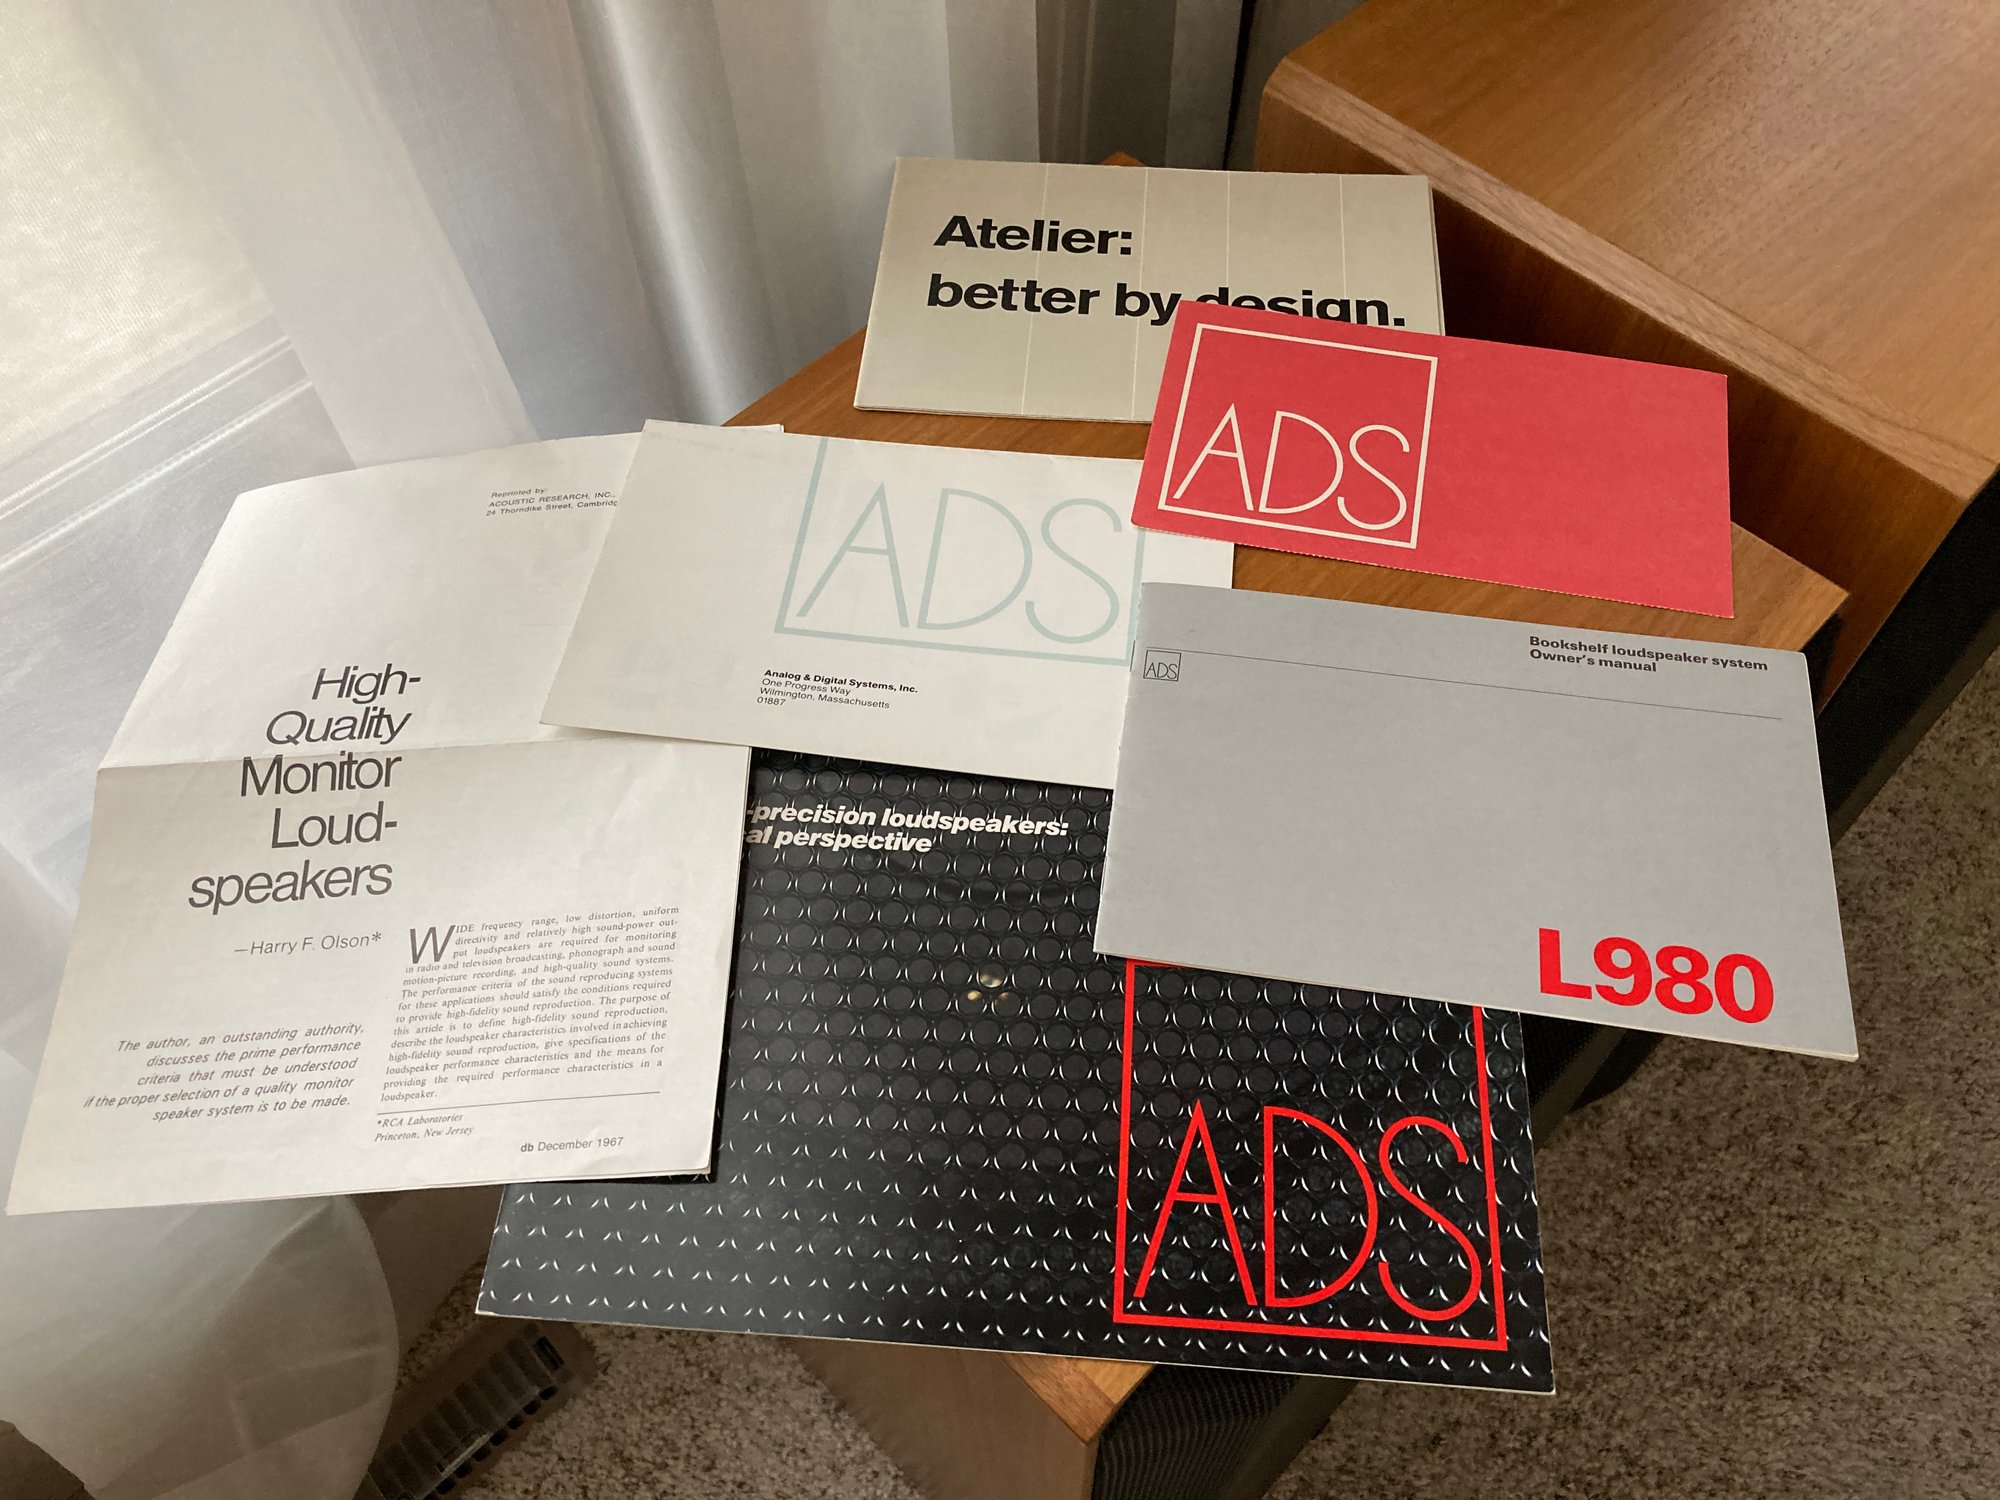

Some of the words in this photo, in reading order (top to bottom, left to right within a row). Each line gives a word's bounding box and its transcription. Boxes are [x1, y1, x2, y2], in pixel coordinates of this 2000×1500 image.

[933, 214, 1133, 256] Atelier:
[926, 273, 1100, 315] better
[1114, 282, 1183, 327] by
[1173, 402, 1411, 531] ADS
[488, 497, 535, 508] ACOUSTIC
[538, 493, 590, 503] RESEARCH,
[491, 488, 531, 499] Reprinted
[485, 509, 496, 517] 24
[500, 505, 542, 515] Thorndike
[545, 502, 573, 511] Street,
[796, 481, 1122, 644] ADS
[1529, 635, 1609, 654] Bookshelf
[1612, 644, 1708, 665] loudspeaker
[1711, 657, 1768, 671] system
[1530, 649, 1595, 666] Owner's
[1599, 657, 1657, 673] manual
[311, 663, 421, 704] High-
[764, 669, 801, 681] Analog
[813, 674, 847, 686] Digital
[849, 679, 897, 692] Systems,
[899, 684, 918, 693] Inc.
[1145, 662, 1178, 680] ADS
[756, 697, 786, 706] 01887
[760, 687, 814, 701] Wilmington,
[818, 694, 890, 709] Massachusetts
[762, 678, 783, 687] One
[785, 681, 828, 693] Progress
[830, 686, 851, 696] Way
[266, 706, 412, 746] Quality
[240, 750, 402, 797] Monitor
[271, 800, 398, 849] Loud-
[747, 804, 876, 826] -precision
[881, 808, 1068, 836] loudspeakers:
[745, 826, 773, 844] al
[773, 830, 933, 853] perspective
[188, 859, 393, 916] speakers
[455, 934, 498, 945] directivity
[503, 932, 520, 940] and
[526, 927, 567, 938] relatively
[572, 925, 591, 935] high
[596, 920, 654, 932] sound-power
[659, 919, 678, 927] out-
[481, 920, 522, 931] frequency
[531, 918, 558, 926] range,
[566, 915, 582, 923] low
[588, 911, 635, 921] distortion,
[643, 906, 679, 916] uniform
[302, 937, 315, 952] F.
[416, 963, 440, 972] radio
[442, 961, 459, 970] and
[462, 958, 502, 969] television
[505, 953, 565, 964] broadcasting,
[569, 946, 624, 959] phonograph
[627, 945, 645, 953] and
[648, 942, 676, 951] sound
[453, 949, 467, 959] put
[474, 943, 531, 955] loudspeakers
[561, 936, 599, 947] required
[605, 934, 619, 943] for
[626, 930, 677, 941] monitoring
[401, 989, 418, 998] The
[422, 985, 477, 998] performance
[481, 981, 512, 990] criteria
[517, 978, 527, 986] of
[531, 977, 545, 985] the
[548, 974, 576, 983] sound
[579, 970, 634, 982] reproducing
[637, 968, 673, 978] systems
[403, 975, 467, 985] motion-picture
[472, 968, 516, 979] recording,
[521, 965, 538, 974] and
[544, 961, 599, 973] high-quality
[603, 958, 630, 967] sound
[635, 956, 674, 966] systems.
[1537, 927, 1775, 1025] L980
[398, 1002, 412, 1011] for
[415, 1000, 437, 1009] these
[442, 995, 495, 1008] applications
[499, 991, 529, 1002] should
[532, 988, 560, 998] satisfy
[564, 987, 578, 995] the
[581, 983, 629, 994] conditions
[632, 980, 671, 991] required
[117, 1040, 140, 1052] The
[146, 1037, 191, 1049] author,
[199, 1035, 215, 1045] an
[222, 1028, 298, 1043] outstanding
[146, 1053, 210, 1067] discusses
[214, 1050, 235, 1062] the
[239, 1047, 276, 1062] prime
[280, 1041, 361, 1059] performance
[389, 1049, 442, 1062] high-fidelity
[446, 1046, 473, 1056] sound
[478, 1041, 539, 1055] reproduction,
[544, 1039, 563, 1049] give
[568, 1035, 631, 1047] specifications
[636, 1032, 647, 1041] of
[651, 1031, 666, 1039] the
[137, 1071, 181, 1086] criteria
[188, 1070, 215, 1082] that
[220, 1066, 255, 1079] must
[262, 1064, 278, 1076] be
[284, 1057, 359, 1074] understood
[386, 1062, 439, 1075] loudspeaker
[442, 1059, 500, 1071] performance
[504, 1051, 569, 1064] characteristics
[574, 1050, 591, 1059] and
[596, 1049, 612, 1057] the
[616, 1046, 646, 1056] means
[650, 1044, 664, 1053] for
[383, 1078, 426, 1090] providing
[434, 1075, 448, 1084] the
[456, 1070, 494, 1083] required
[502, 1067, 560, 1080] performance
[567, 1061, 633, 1073] characteristics
[640, 1060, 650, 1068] in
[83, 1095, 96, 1108] if
[95, 1095, 116, 1107] the
[116, 1094, 161, 1108] proper
[162, 1087, 220, 1102] selection
[223, 1085, 239, 1098] of
[241, 1087, 250, 1096] a
[254, 1080, 298, 1097] quality
[303, 1077, 355, 1091] monitor
[381, 1090, 437, 1102] loudspeaker.
[152, 1107, 204, 1123] speaker
[207, 1103, 254, 1118] system
[257, 1101, 269, 1112] is
[273, 1101, 287, 1112] to
[290, 1098, 307, 1109] be
[311, 1094, 350, 1108] made.
[407, 1113, 463, 1126] Laboratories
[374, 1131, 419, 1142] Princeton,
[423, 1128, 444, 1137] New
[445, 1126, 473, 1136] Jersey
[521, 1142, 534, 1152] db
[537, 1138, 593, 1152] December
[597, 1136, 624, 1149] 1967
[1134, 1099, 1482, 1322] ADS
